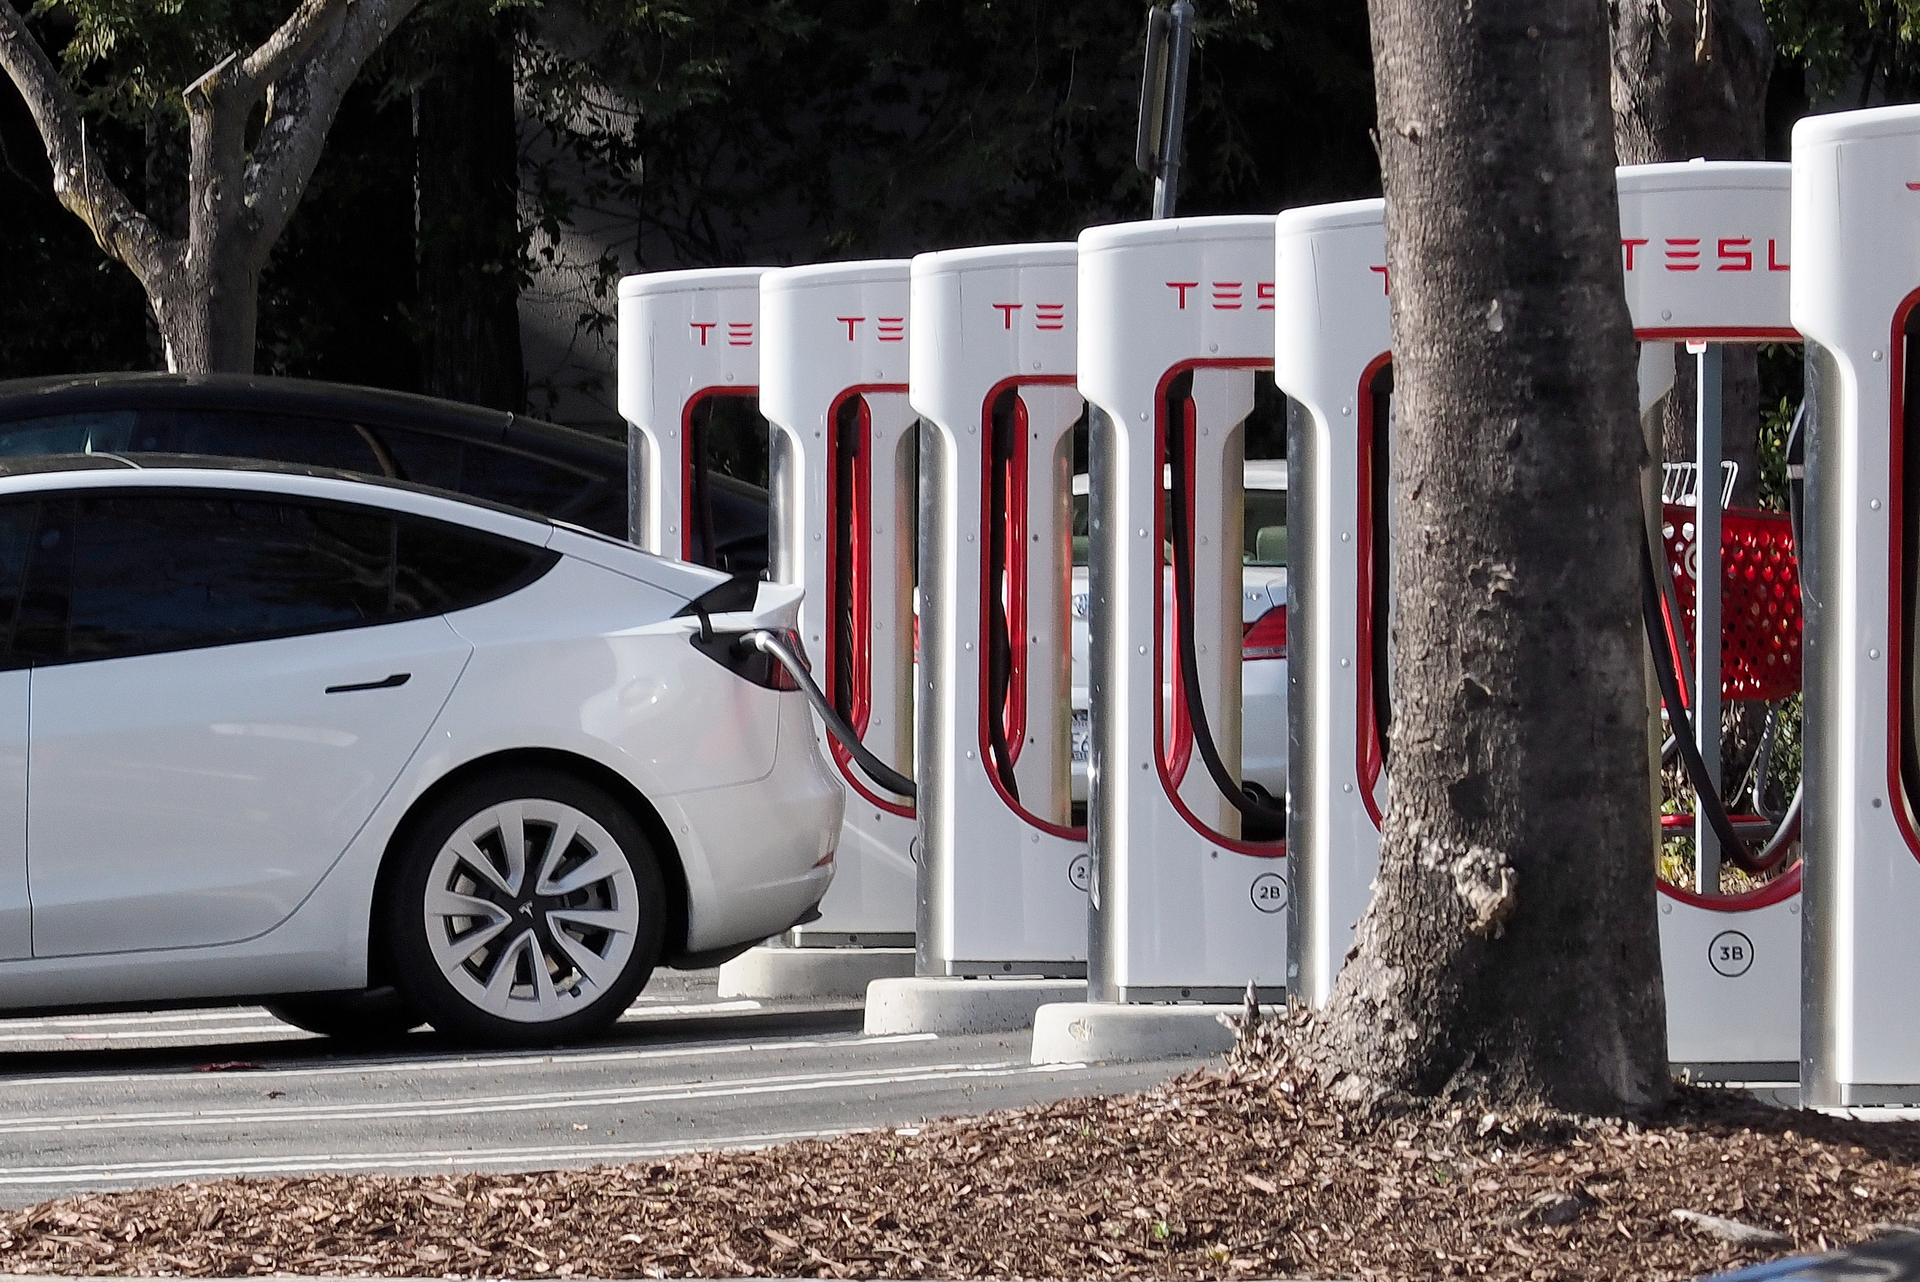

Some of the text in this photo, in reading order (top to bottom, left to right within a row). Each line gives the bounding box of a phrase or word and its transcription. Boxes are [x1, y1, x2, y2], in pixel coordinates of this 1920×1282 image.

[992, 303, 1064, 330] TE
[689, 322, 753, 346] TE
[836, 317, 904, 341] TE
[1077, 866, 1089, 879] 2
[1260, 886, 1280, 899] 2B
[1720, 946, 1743, 960] 3B
